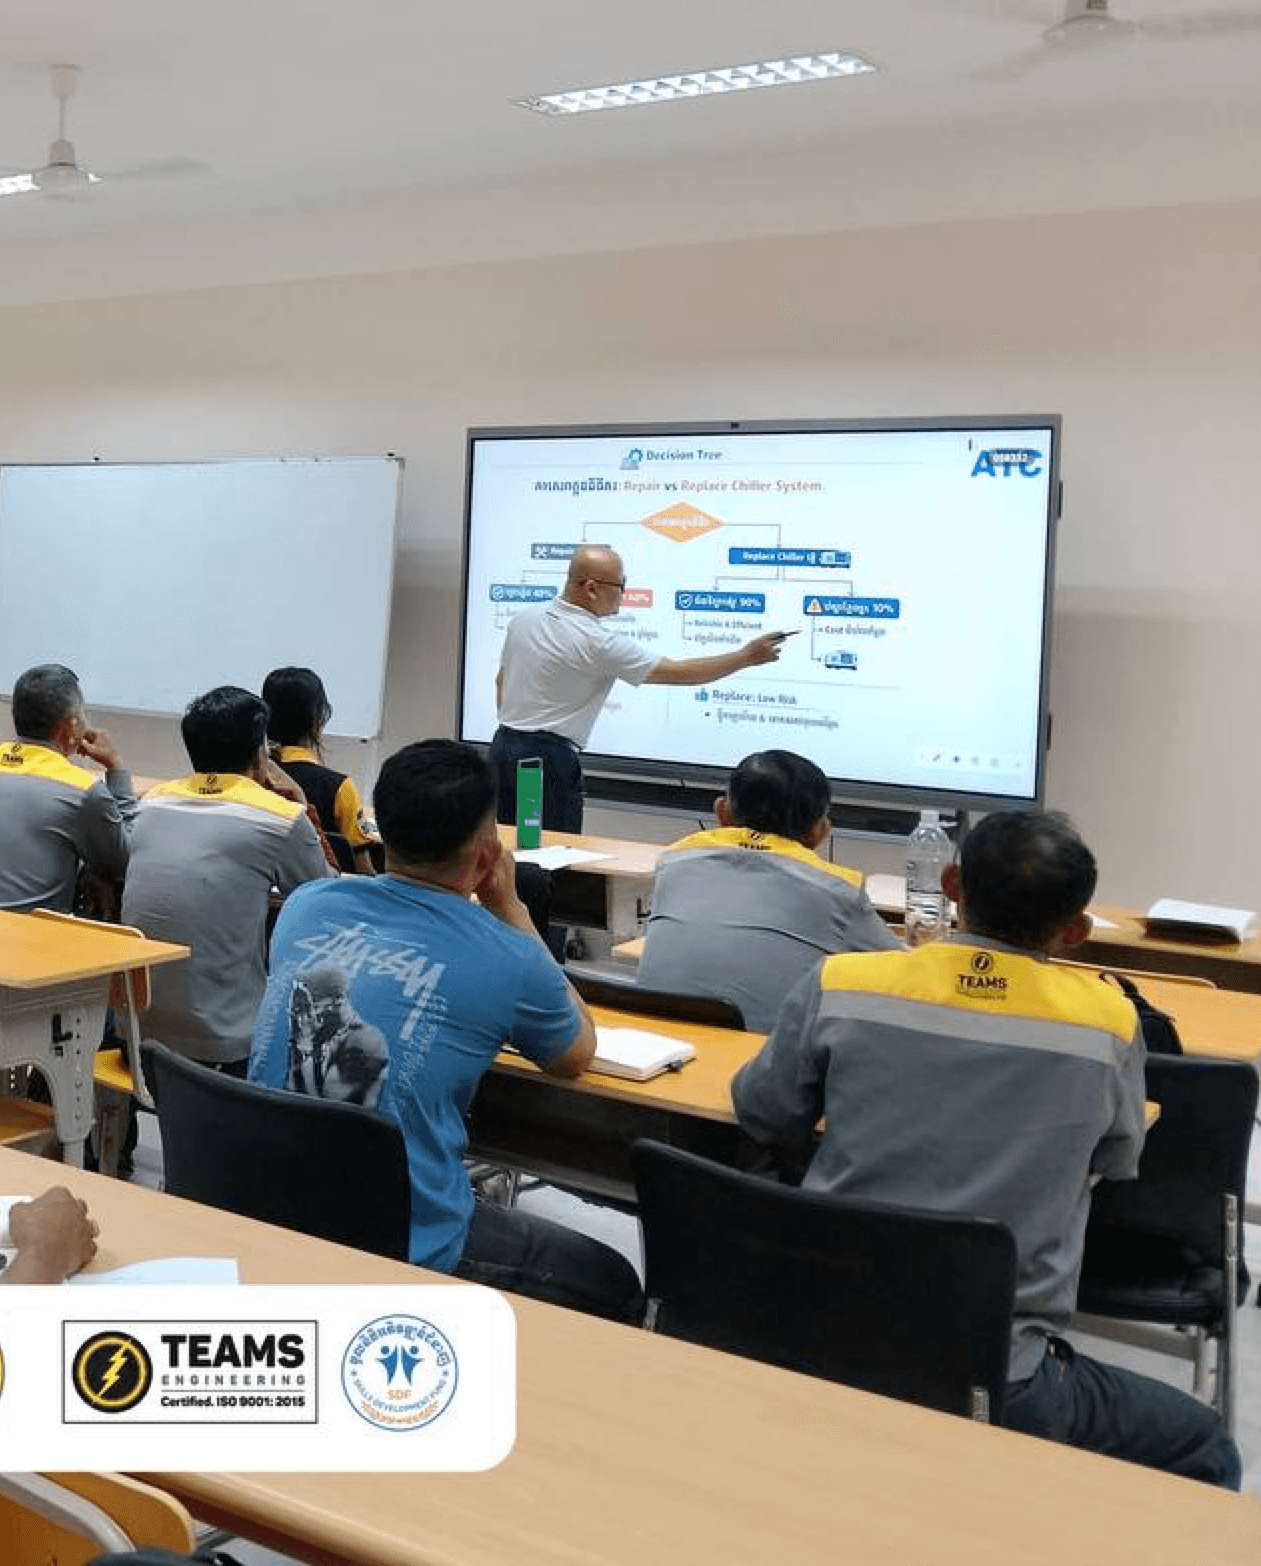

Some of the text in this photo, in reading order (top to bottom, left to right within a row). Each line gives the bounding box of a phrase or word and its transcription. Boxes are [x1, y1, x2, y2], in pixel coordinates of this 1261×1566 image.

[645, 449, 723, 462] Decision Tree
[622, 479, 661, 495] Repair
[664, 480, 678, 492] vs
[680, 480, 728, 495] Replace
[731, 479, 772, 493] Chiller
[956, 973, 1008, 989] TEAMS
